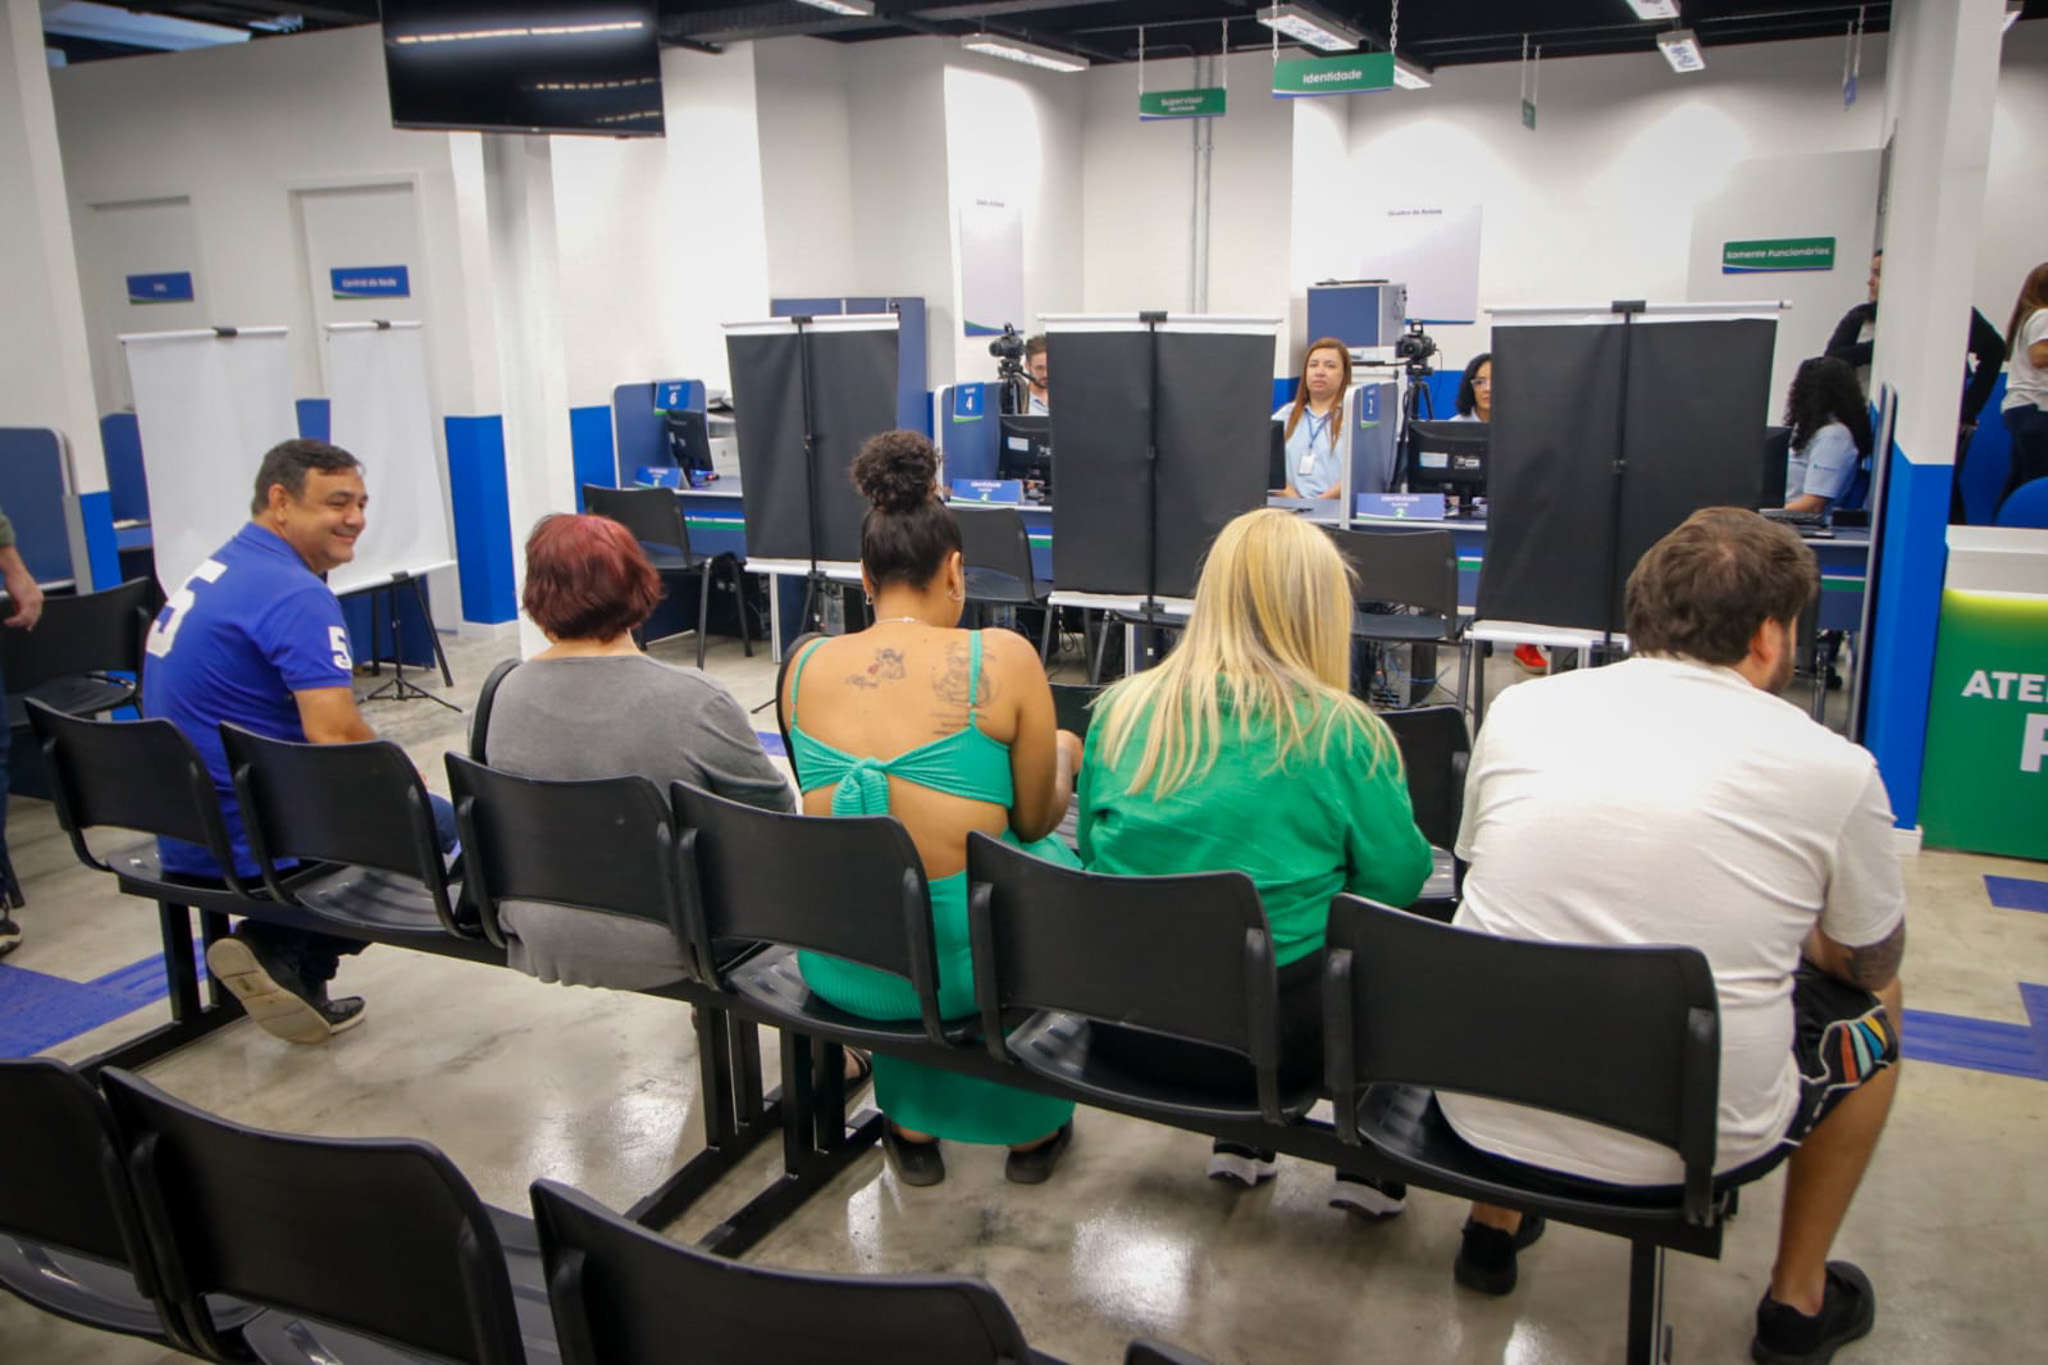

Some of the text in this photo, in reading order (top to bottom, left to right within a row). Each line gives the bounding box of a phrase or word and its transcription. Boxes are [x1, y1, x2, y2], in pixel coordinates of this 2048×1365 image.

[1303, 69, 1362, 84] Identidade
[668, 391, 678, 406] 6
[965, 395, 974, 411] 4
[1396, 507, 1405, 518] 2
[146, 557, 229, 659] 5
[328, 625, 352, 670] 5
[1961, 669, 2048, 703] ATE
